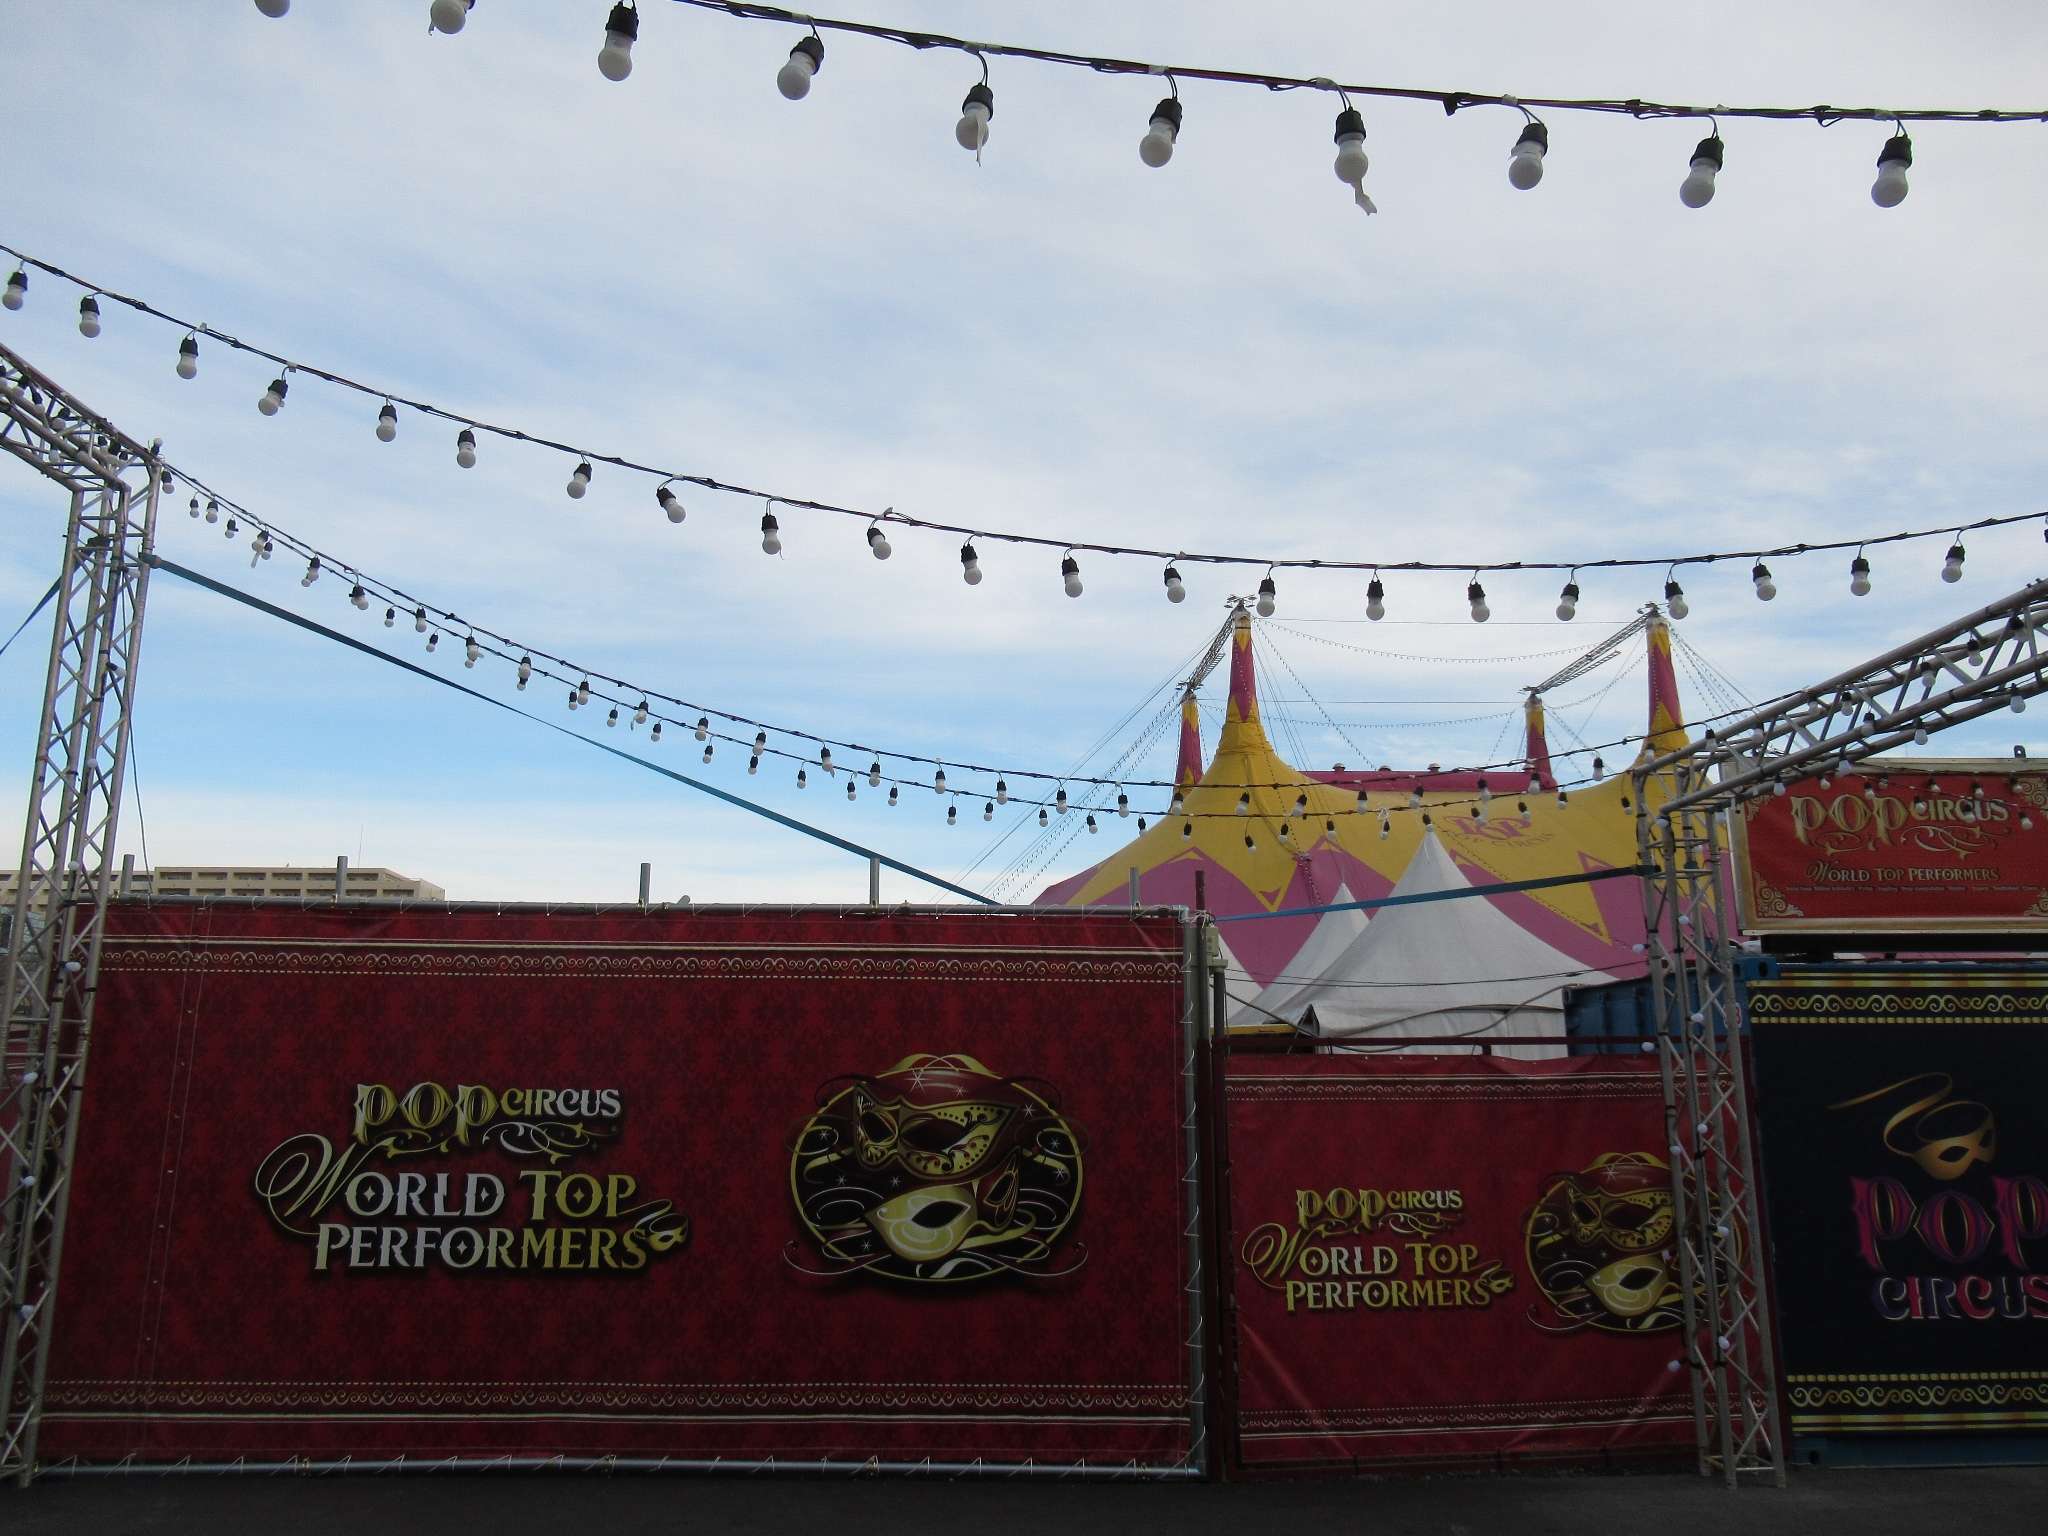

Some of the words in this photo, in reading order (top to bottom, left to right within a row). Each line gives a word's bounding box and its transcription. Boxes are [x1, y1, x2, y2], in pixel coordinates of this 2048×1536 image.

[1790, 793, 1907, 848] POP
[1806, 859, 1870, 882] WORLD
[1876, 867, 1904, 881] TOP
[1908, 868, 1999, 881] PERFORMERS
[353, 1081, 500, 1146] POP
[501, 1088, 622, 1118] CIRCUS
[255, 1133, 506, 1235] WORLD
[520, 1170, 637, 1221] TOP
[1296, 1187, 1386, 1231] POP
[1387, 1189, 1464, 1209] CIRCUS
[314, 1222, 648, 1270] PERFORMERS
[1850, 1175, 2048, 1272] POP
[1242, 1222, 1398, 1290] WORLD
[1405, 1243, 1479, 1275] TOP
[1285, 1279, 1492, 1312] PERFORMERS
[1872, 1275, 2048, 1320] CIRCUS
